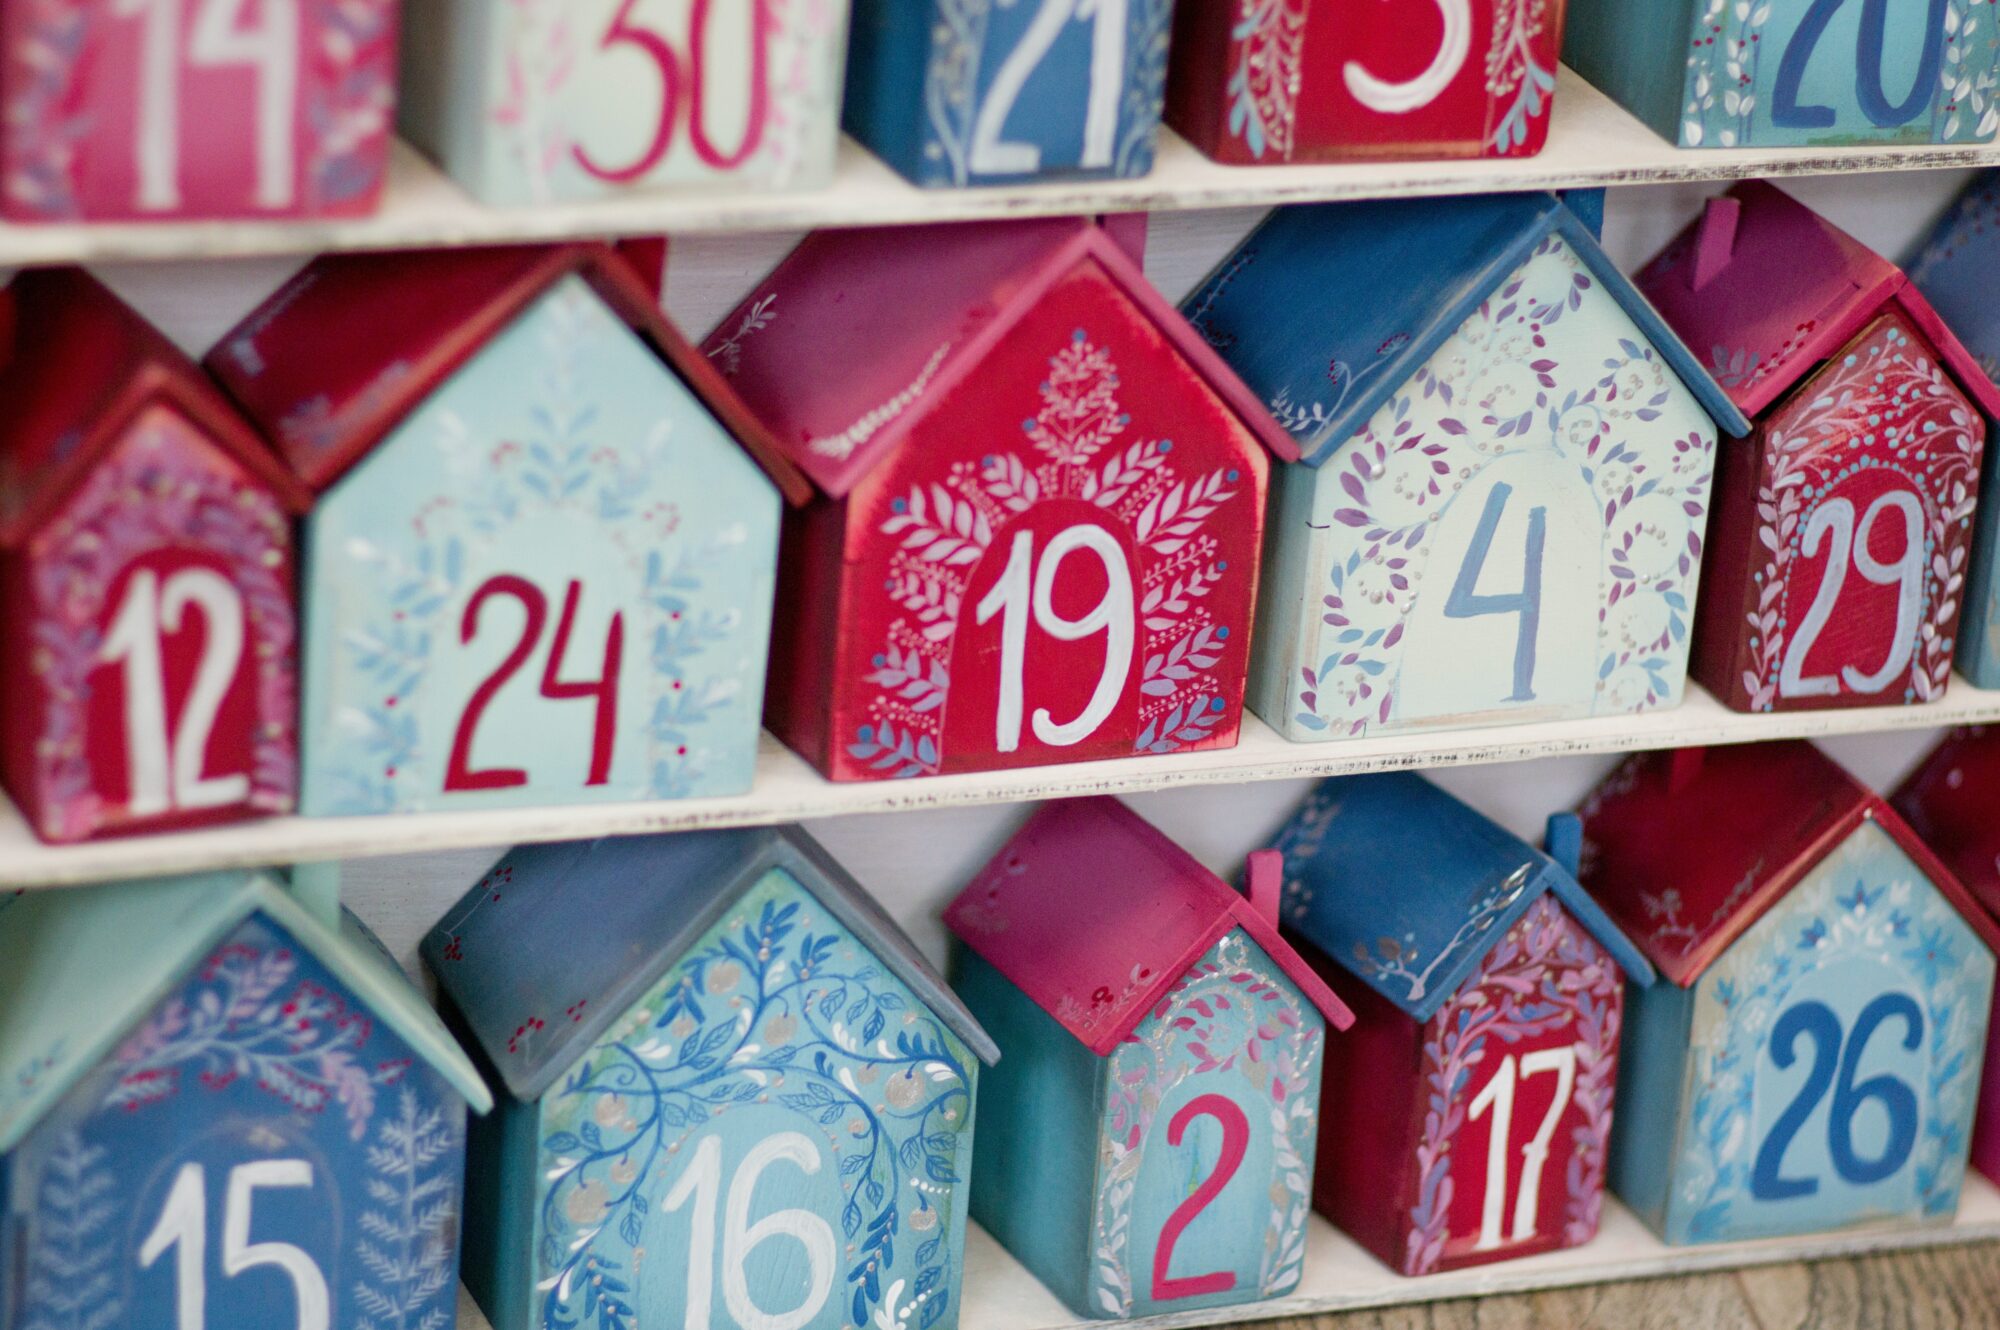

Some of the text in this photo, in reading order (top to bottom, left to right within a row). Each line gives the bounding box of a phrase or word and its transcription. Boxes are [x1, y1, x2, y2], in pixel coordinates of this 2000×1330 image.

[110, 0, 297, 210] 14
[571, 0, 768, 185] 30
[969, 0, 1128, 173] 21
[99, 566, 250, 813] 12
[443, 574, 623, 792] 24
[977, 524, 1135, 751] 19
[1444, 481, 1546, 701] 4
[1780, 491, 1926, 697] 29
[1151, 1094, 1250, 1299] 2
[1468, 1046, 1575, 1249] 17
[1752, 993, 1924, 1199] 26
[138, 1159, 330, 1330] 15
[661, 1132, 837, 1330] 16
